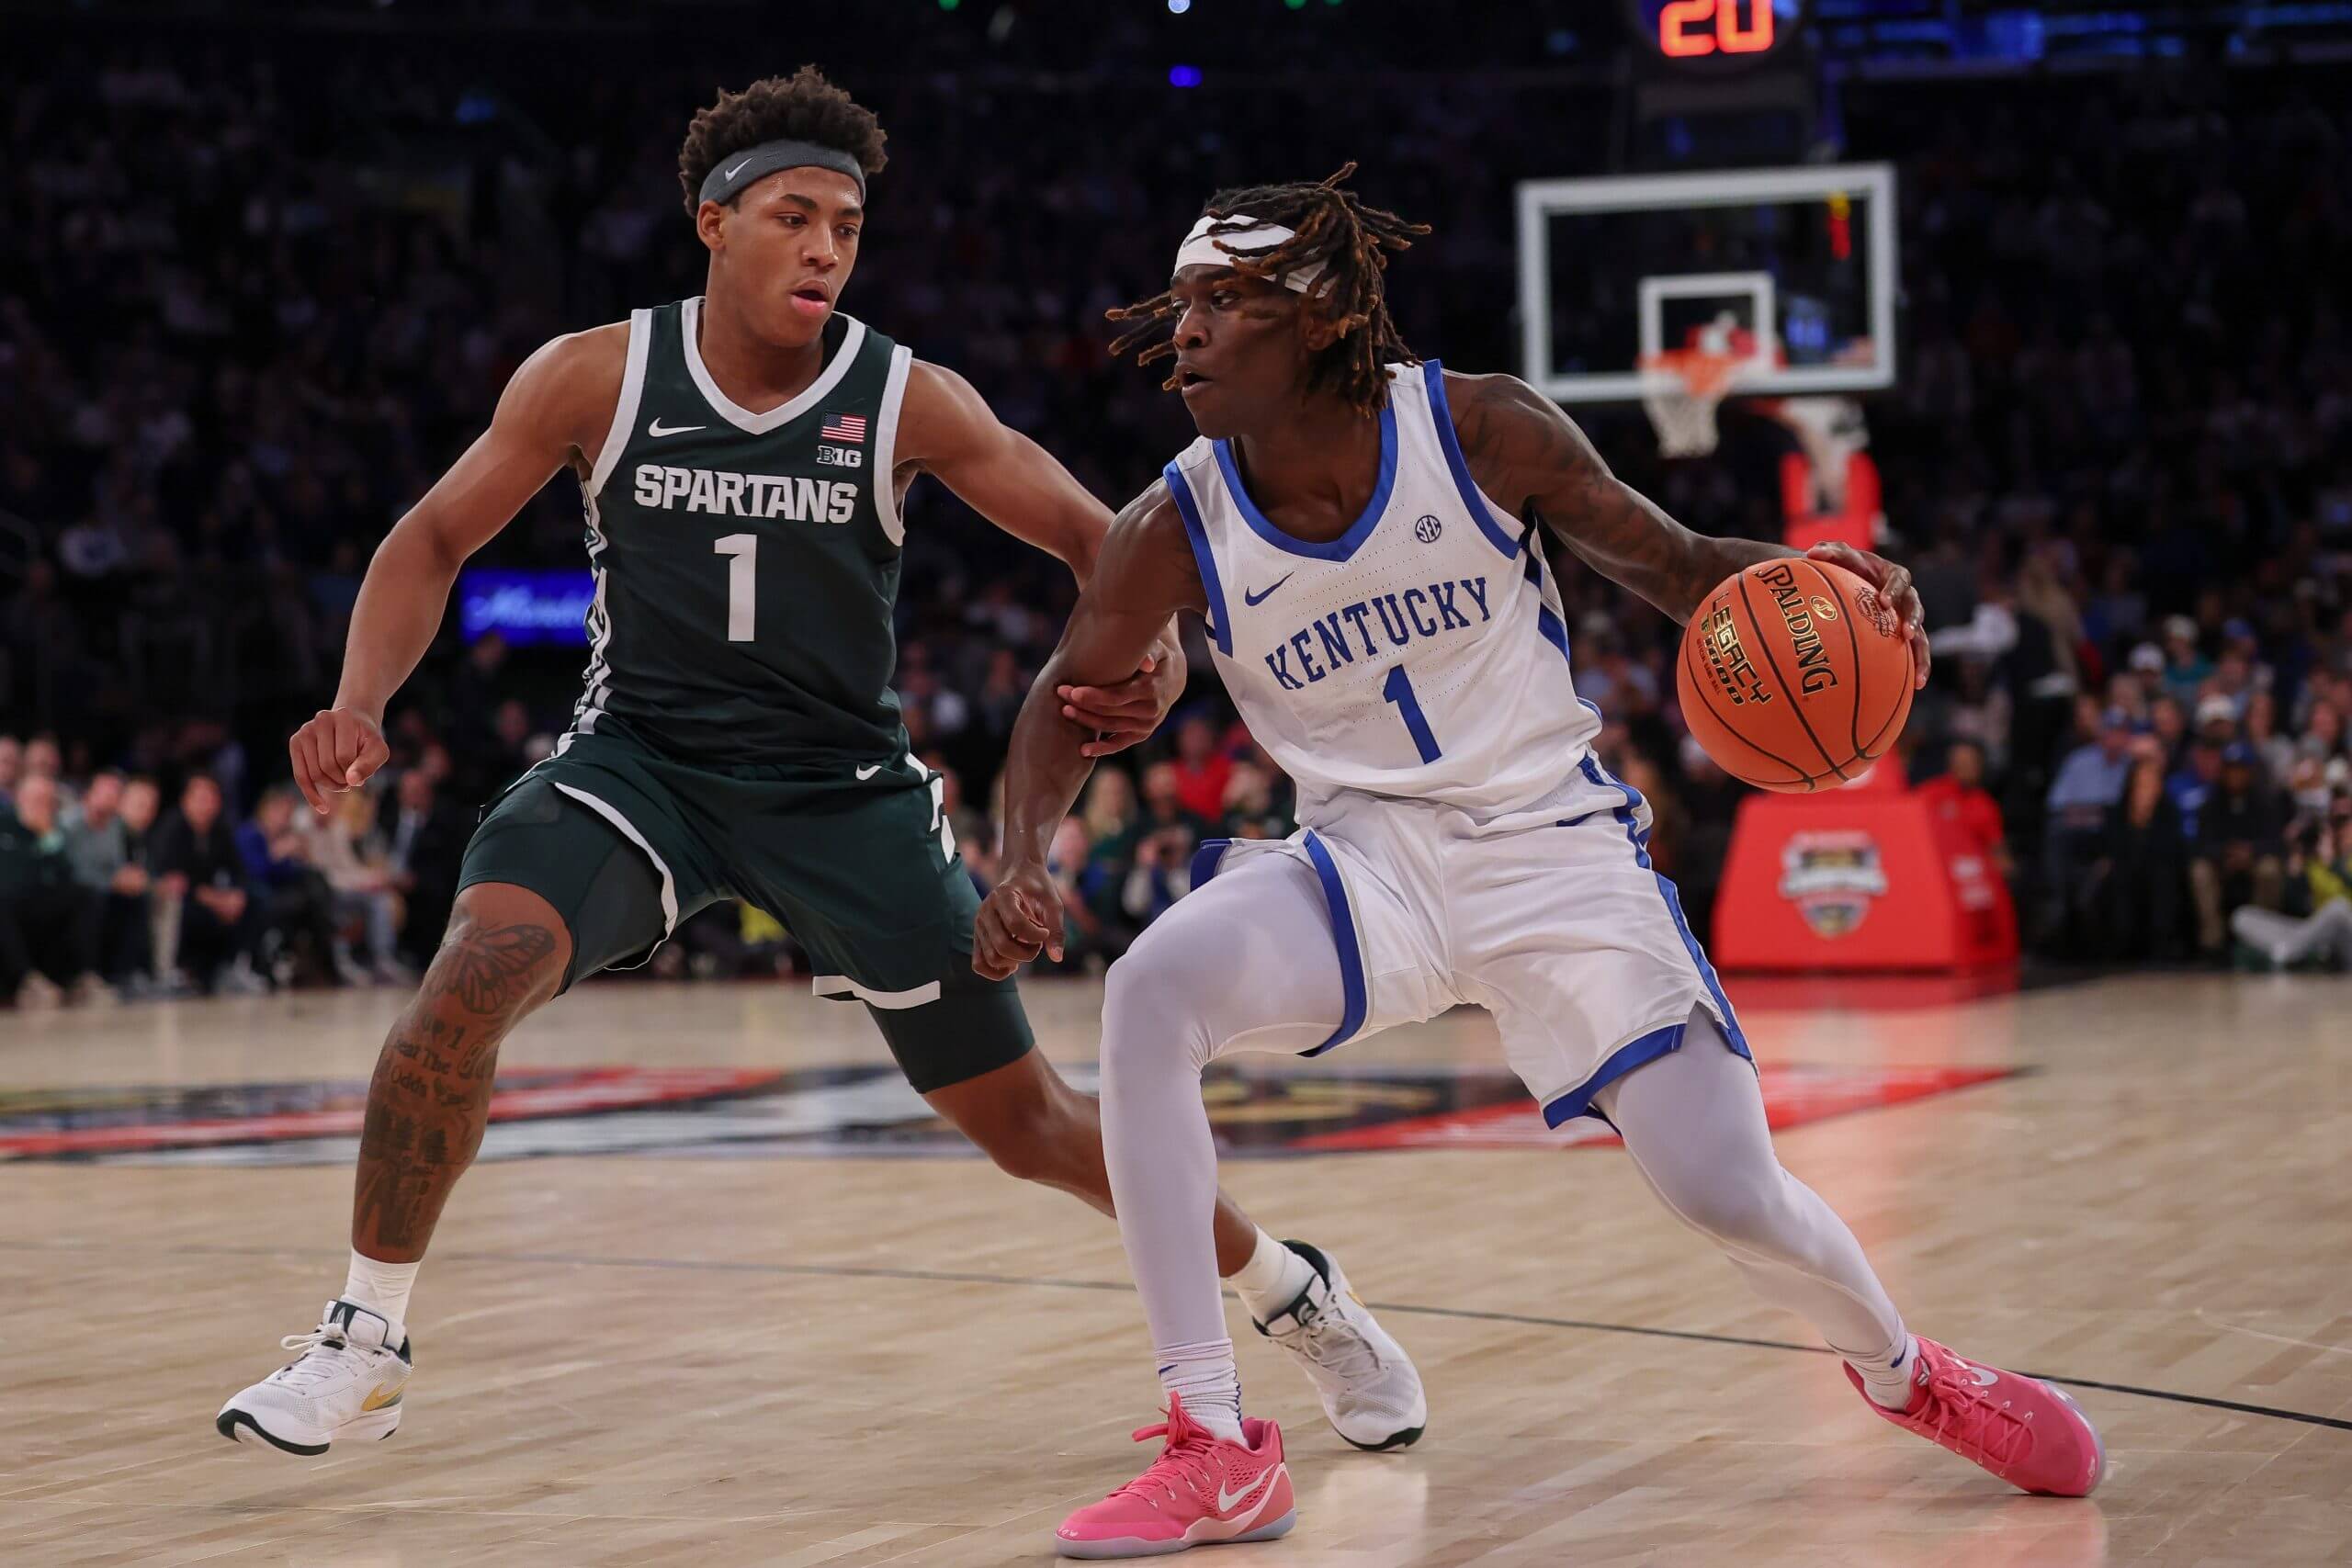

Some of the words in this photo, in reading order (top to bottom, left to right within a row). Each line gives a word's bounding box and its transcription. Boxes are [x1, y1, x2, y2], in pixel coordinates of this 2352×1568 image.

[634, 464, 858, 524] SPARTANS
[1416, 515, 1442, 543] SEC
[714, 533, 757, 642] 1
[1264, 576, 1491, 691] KENTUCKY
[1754, 563, 1838, 695] SPALDING
[1712, 590, 1772, 705] LEGACY
[1383, 663, 1442, 765] 1
